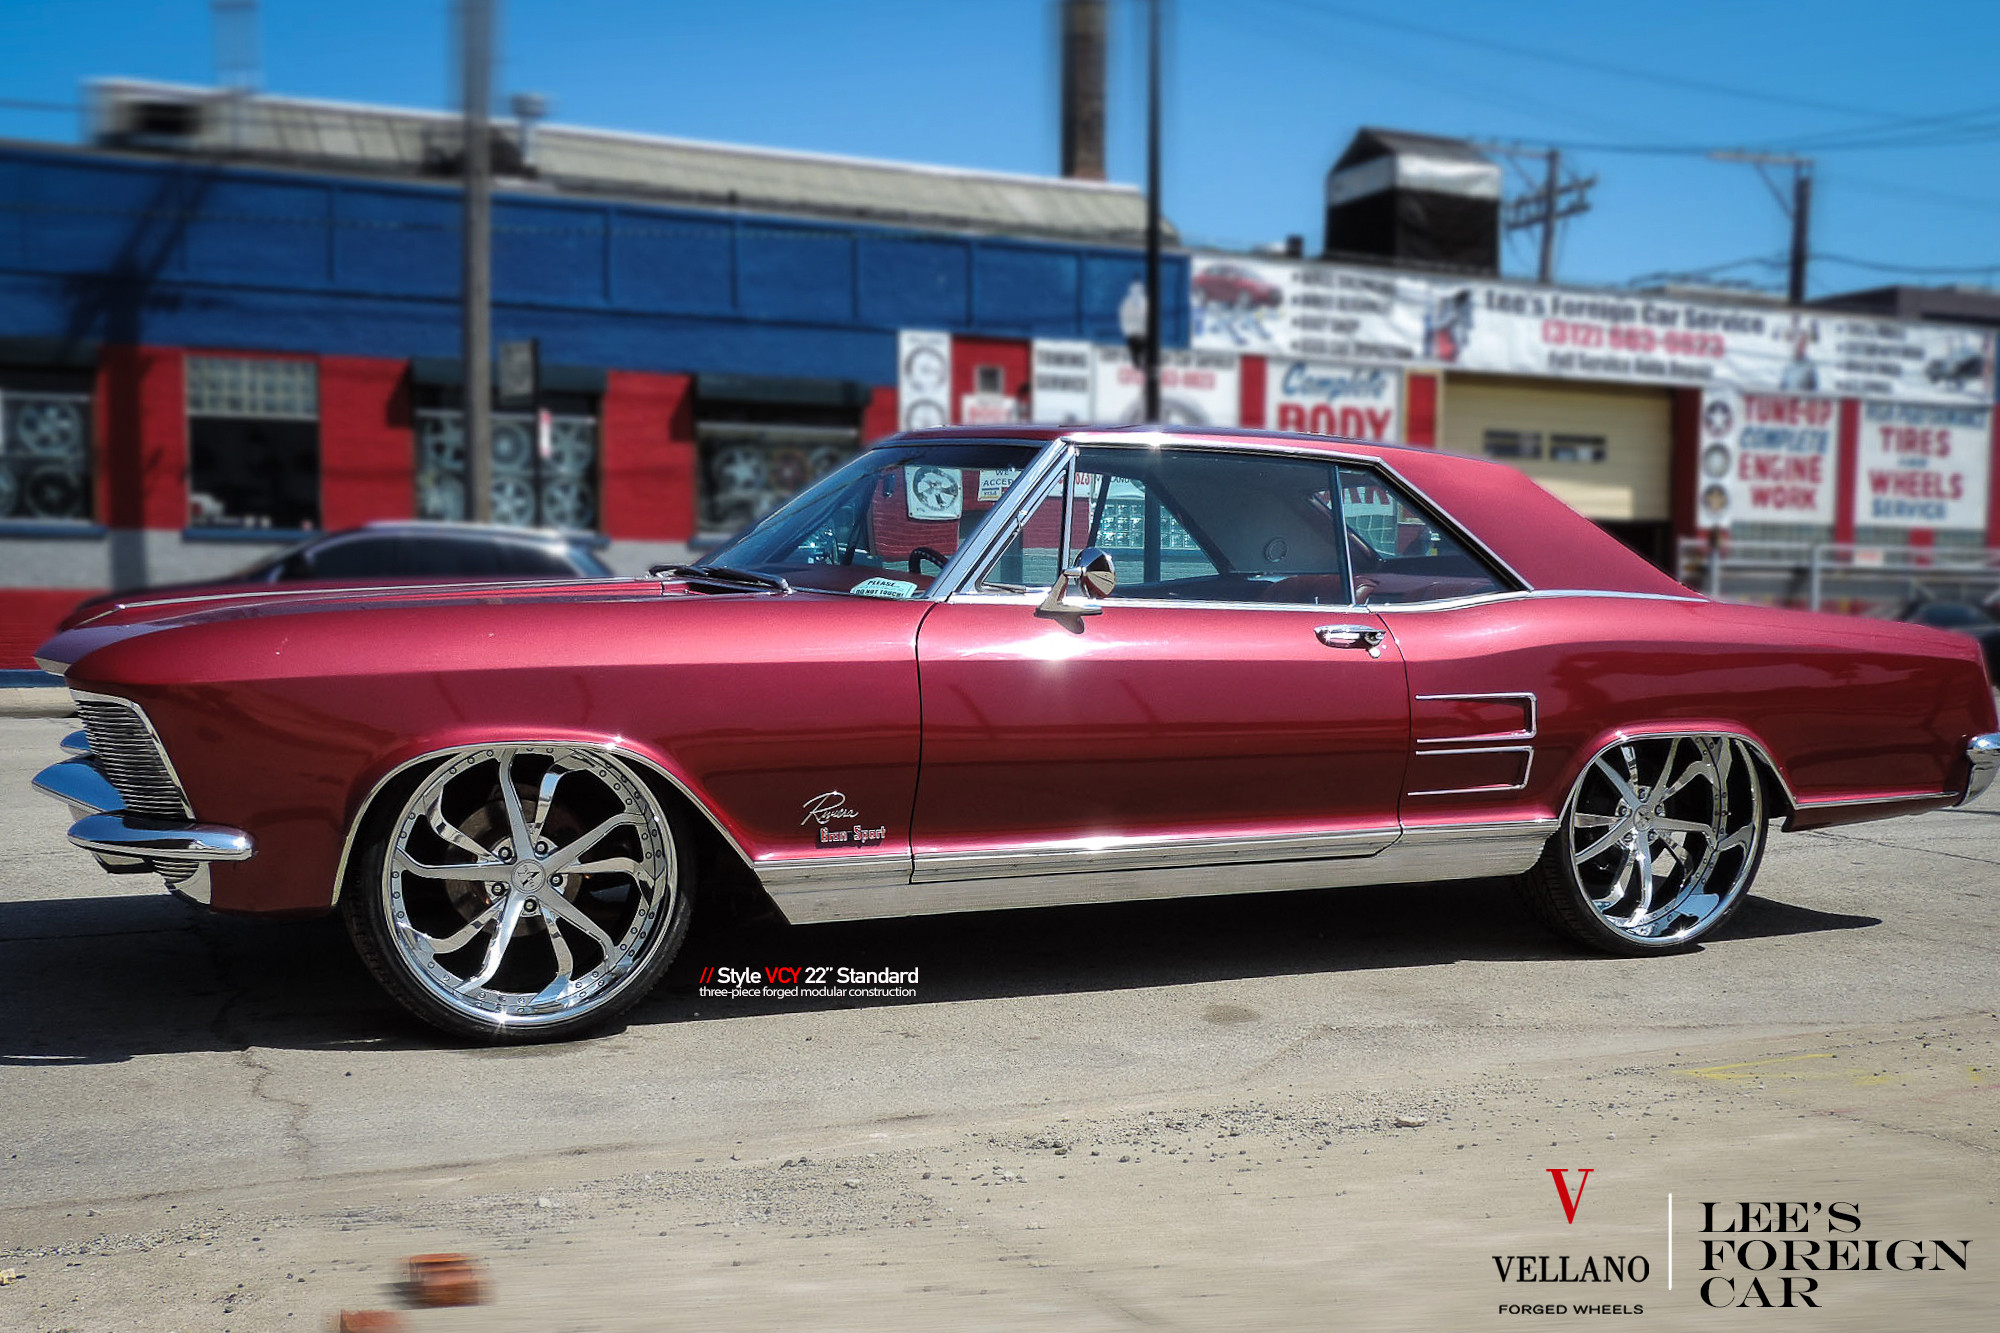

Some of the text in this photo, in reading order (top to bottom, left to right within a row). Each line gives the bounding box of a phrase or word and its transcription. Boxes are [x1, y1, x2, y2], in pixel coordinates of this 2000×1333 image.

[1485, 289, 1766, 334] Lee's Foreign Car Service
[1281, 361, 1387, 402] Complete
[1739, 426, 1829, 453] COMPLETE
[1879, 425, 1951, 458] TIRES
[983, 479, 1014, 487] ACCEP
[1738, 452, 1823, 483] ENGINE
[1751, 485, 1817, 510] WORK
[1868, 470, 1963, 501] WHEELS
[800, 790, 860, 825] Riviera
[820, 824, 887, 844] Gran Sport
